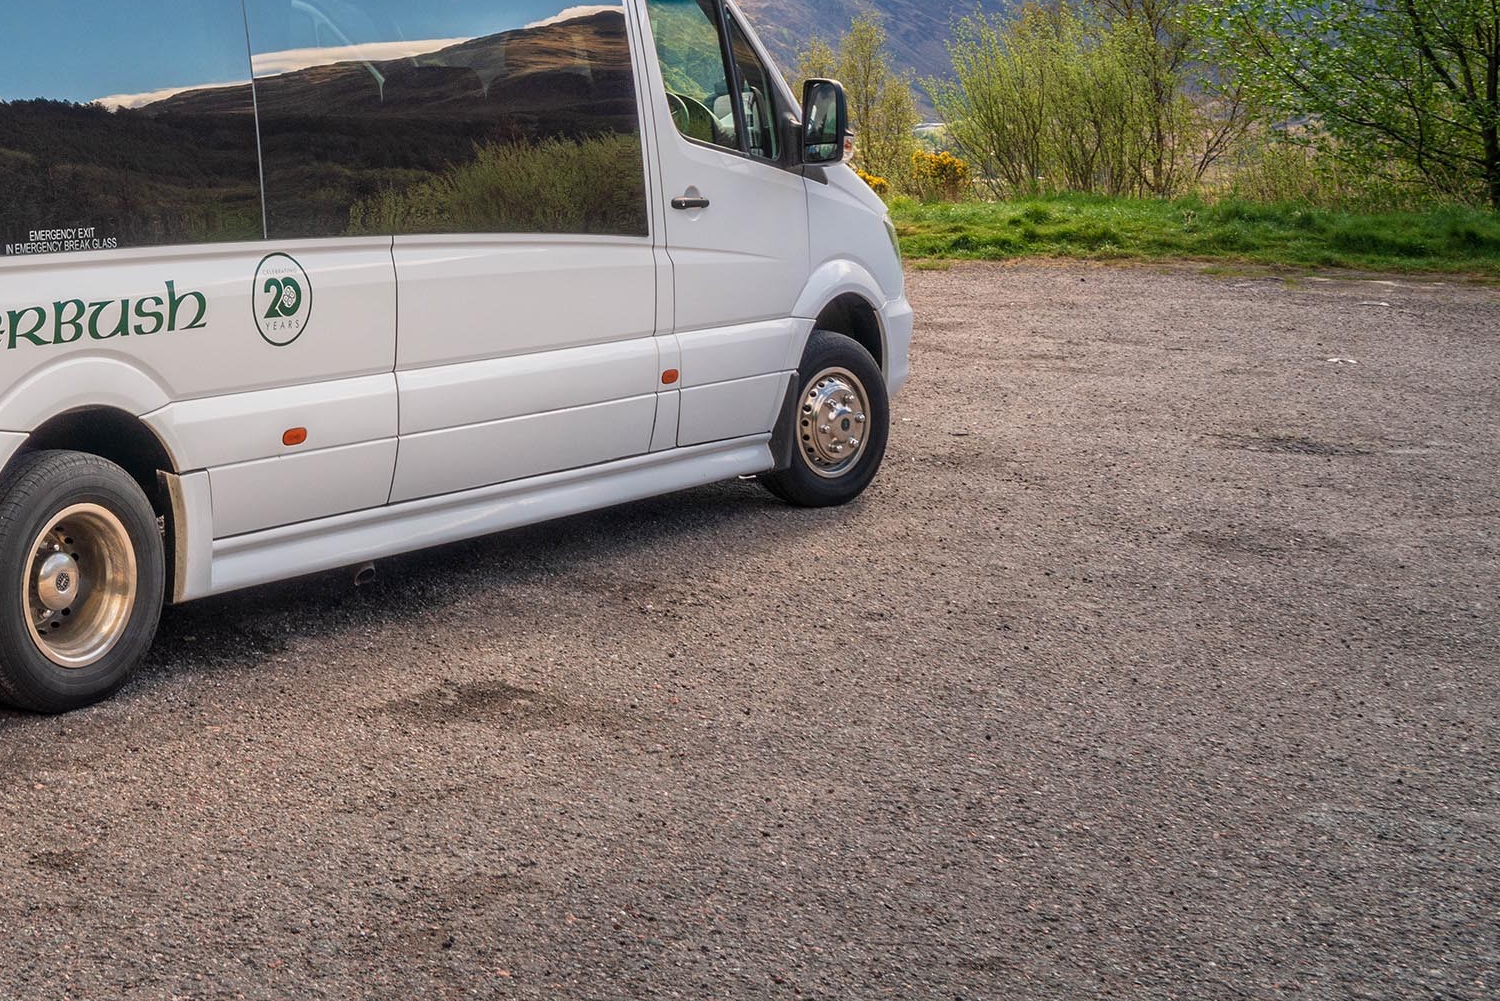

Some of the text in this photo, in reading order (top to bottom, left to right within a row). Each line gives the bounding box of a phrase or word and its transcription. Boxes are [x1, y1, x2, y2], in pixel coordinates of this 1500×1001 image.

[29, 227, 95, 241] EMERGENCY EXIT
[5, 237, 118, 255] IN EMERGENCY BREAK GLASS
[262, 267, 298, 275] CELEBRATING
[263, 276, 302, 318] 20
[265, 319, 300, 331] YEARS
